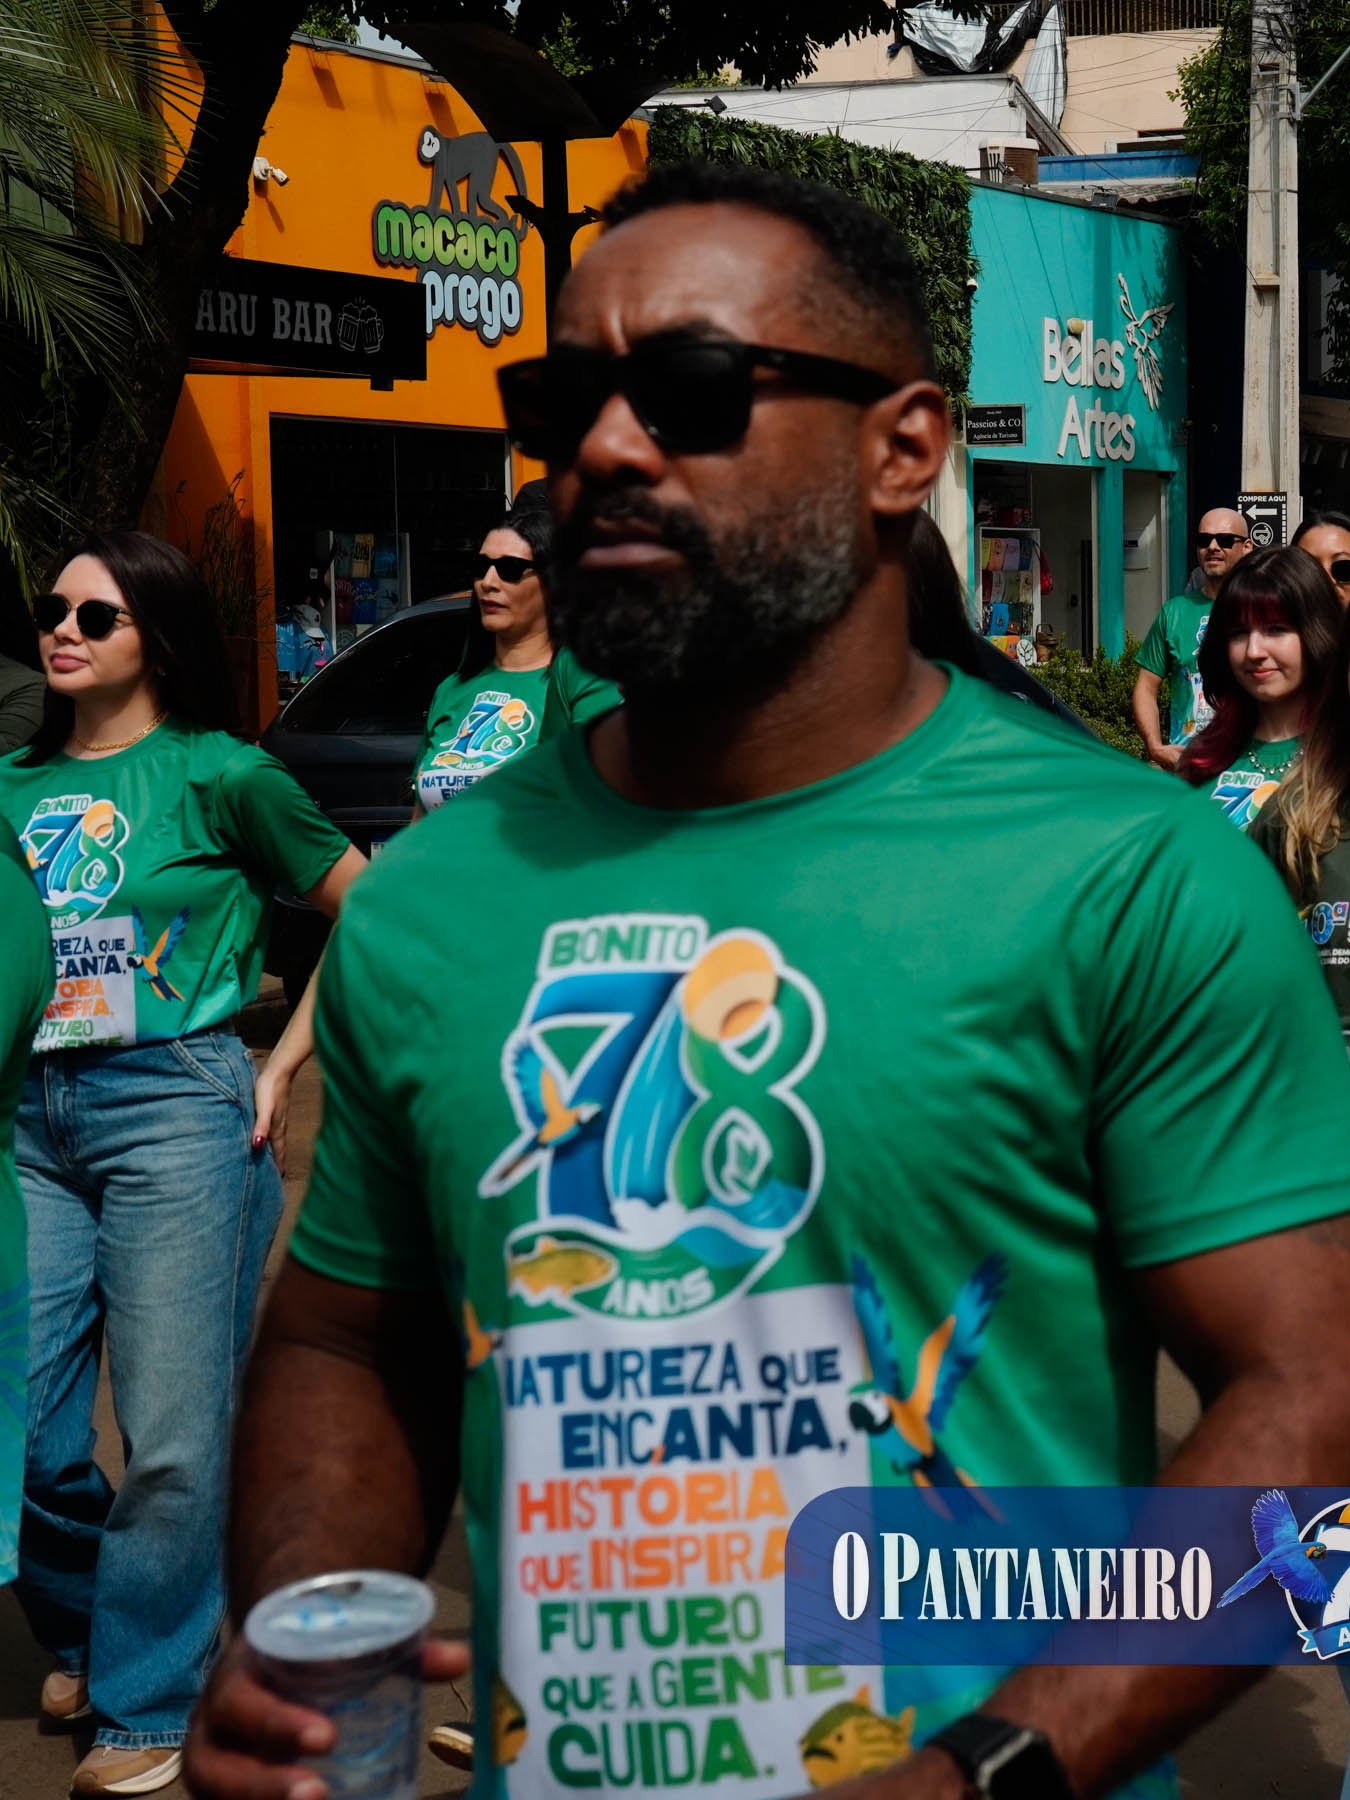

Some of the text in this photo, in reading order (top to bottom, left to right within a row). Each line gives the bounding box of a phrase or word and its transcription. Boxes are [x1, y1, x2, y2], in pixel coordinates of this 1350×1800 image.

[378, 206, 518, 276] macaco
[272, 297, 333, 345] BAR
[423, 270, 521, 340] prego
[1043, 317, 1125, 389] Bellas
[999, 418, 1007, 428] &
[1056, 395, 1136, 462] Artes
[35, 796, 91, 816] BONITO
[1220, 772, 1264, 786] BONITO
[98, 936, 126, 952] QUE
[547, 924, 700, 969] BONITO
[529, 929, 826, 1237] 78
[602, 1266, 715, 1317] ANOS
[760, 1348, 841, 1396] QUE
[560, 1397, 848, 1470] ENCANTA,
[520, 1554, 582, 1598] QUE
[538, 1593, 763, 1654] FUTURO
[543, 1644, 846, 1717] QUE A GENTE
[547, 1715, 776, 1790] CUIDA.
